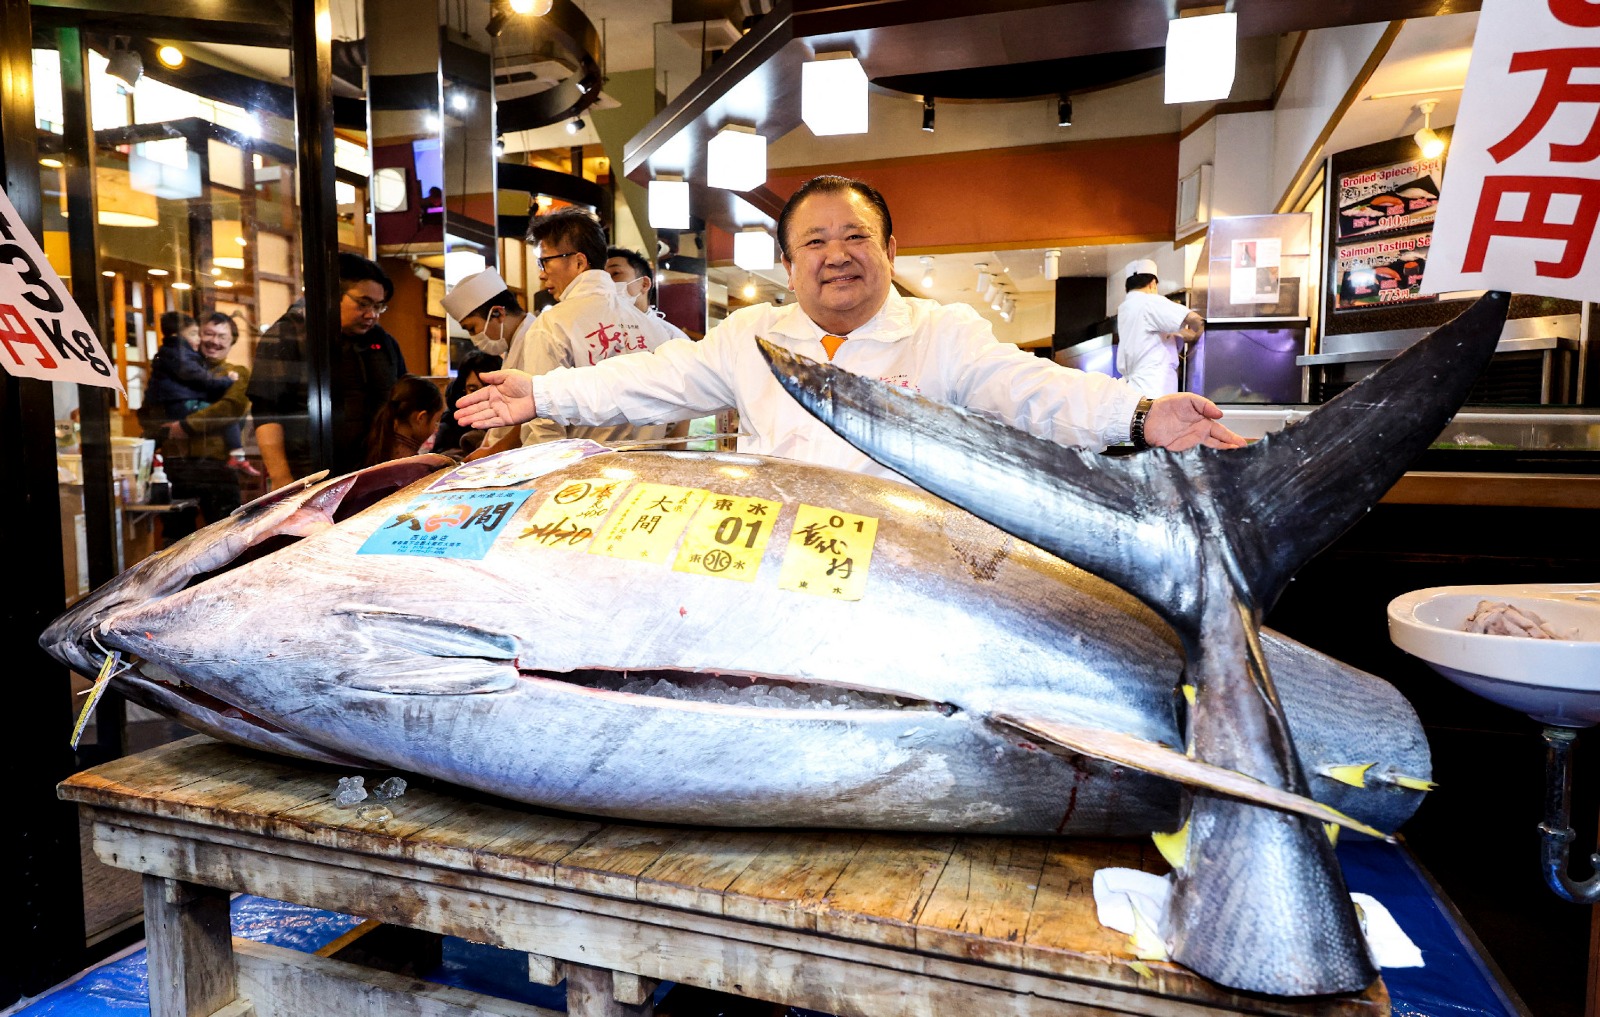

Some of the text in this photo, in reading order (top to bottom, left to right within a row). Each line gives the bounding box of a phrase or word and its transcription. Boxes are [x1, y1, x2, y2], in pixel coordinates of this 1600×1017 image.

[1460, 0, 1600, 279] 万円
[1343, 160, 1439, 188] Broiled 3pieces Set
[1340, 236, 1431, 258] Salmon Tasting Se
[631, 495, 673, 535] 大間
[714, 516, 762, 549] 01
